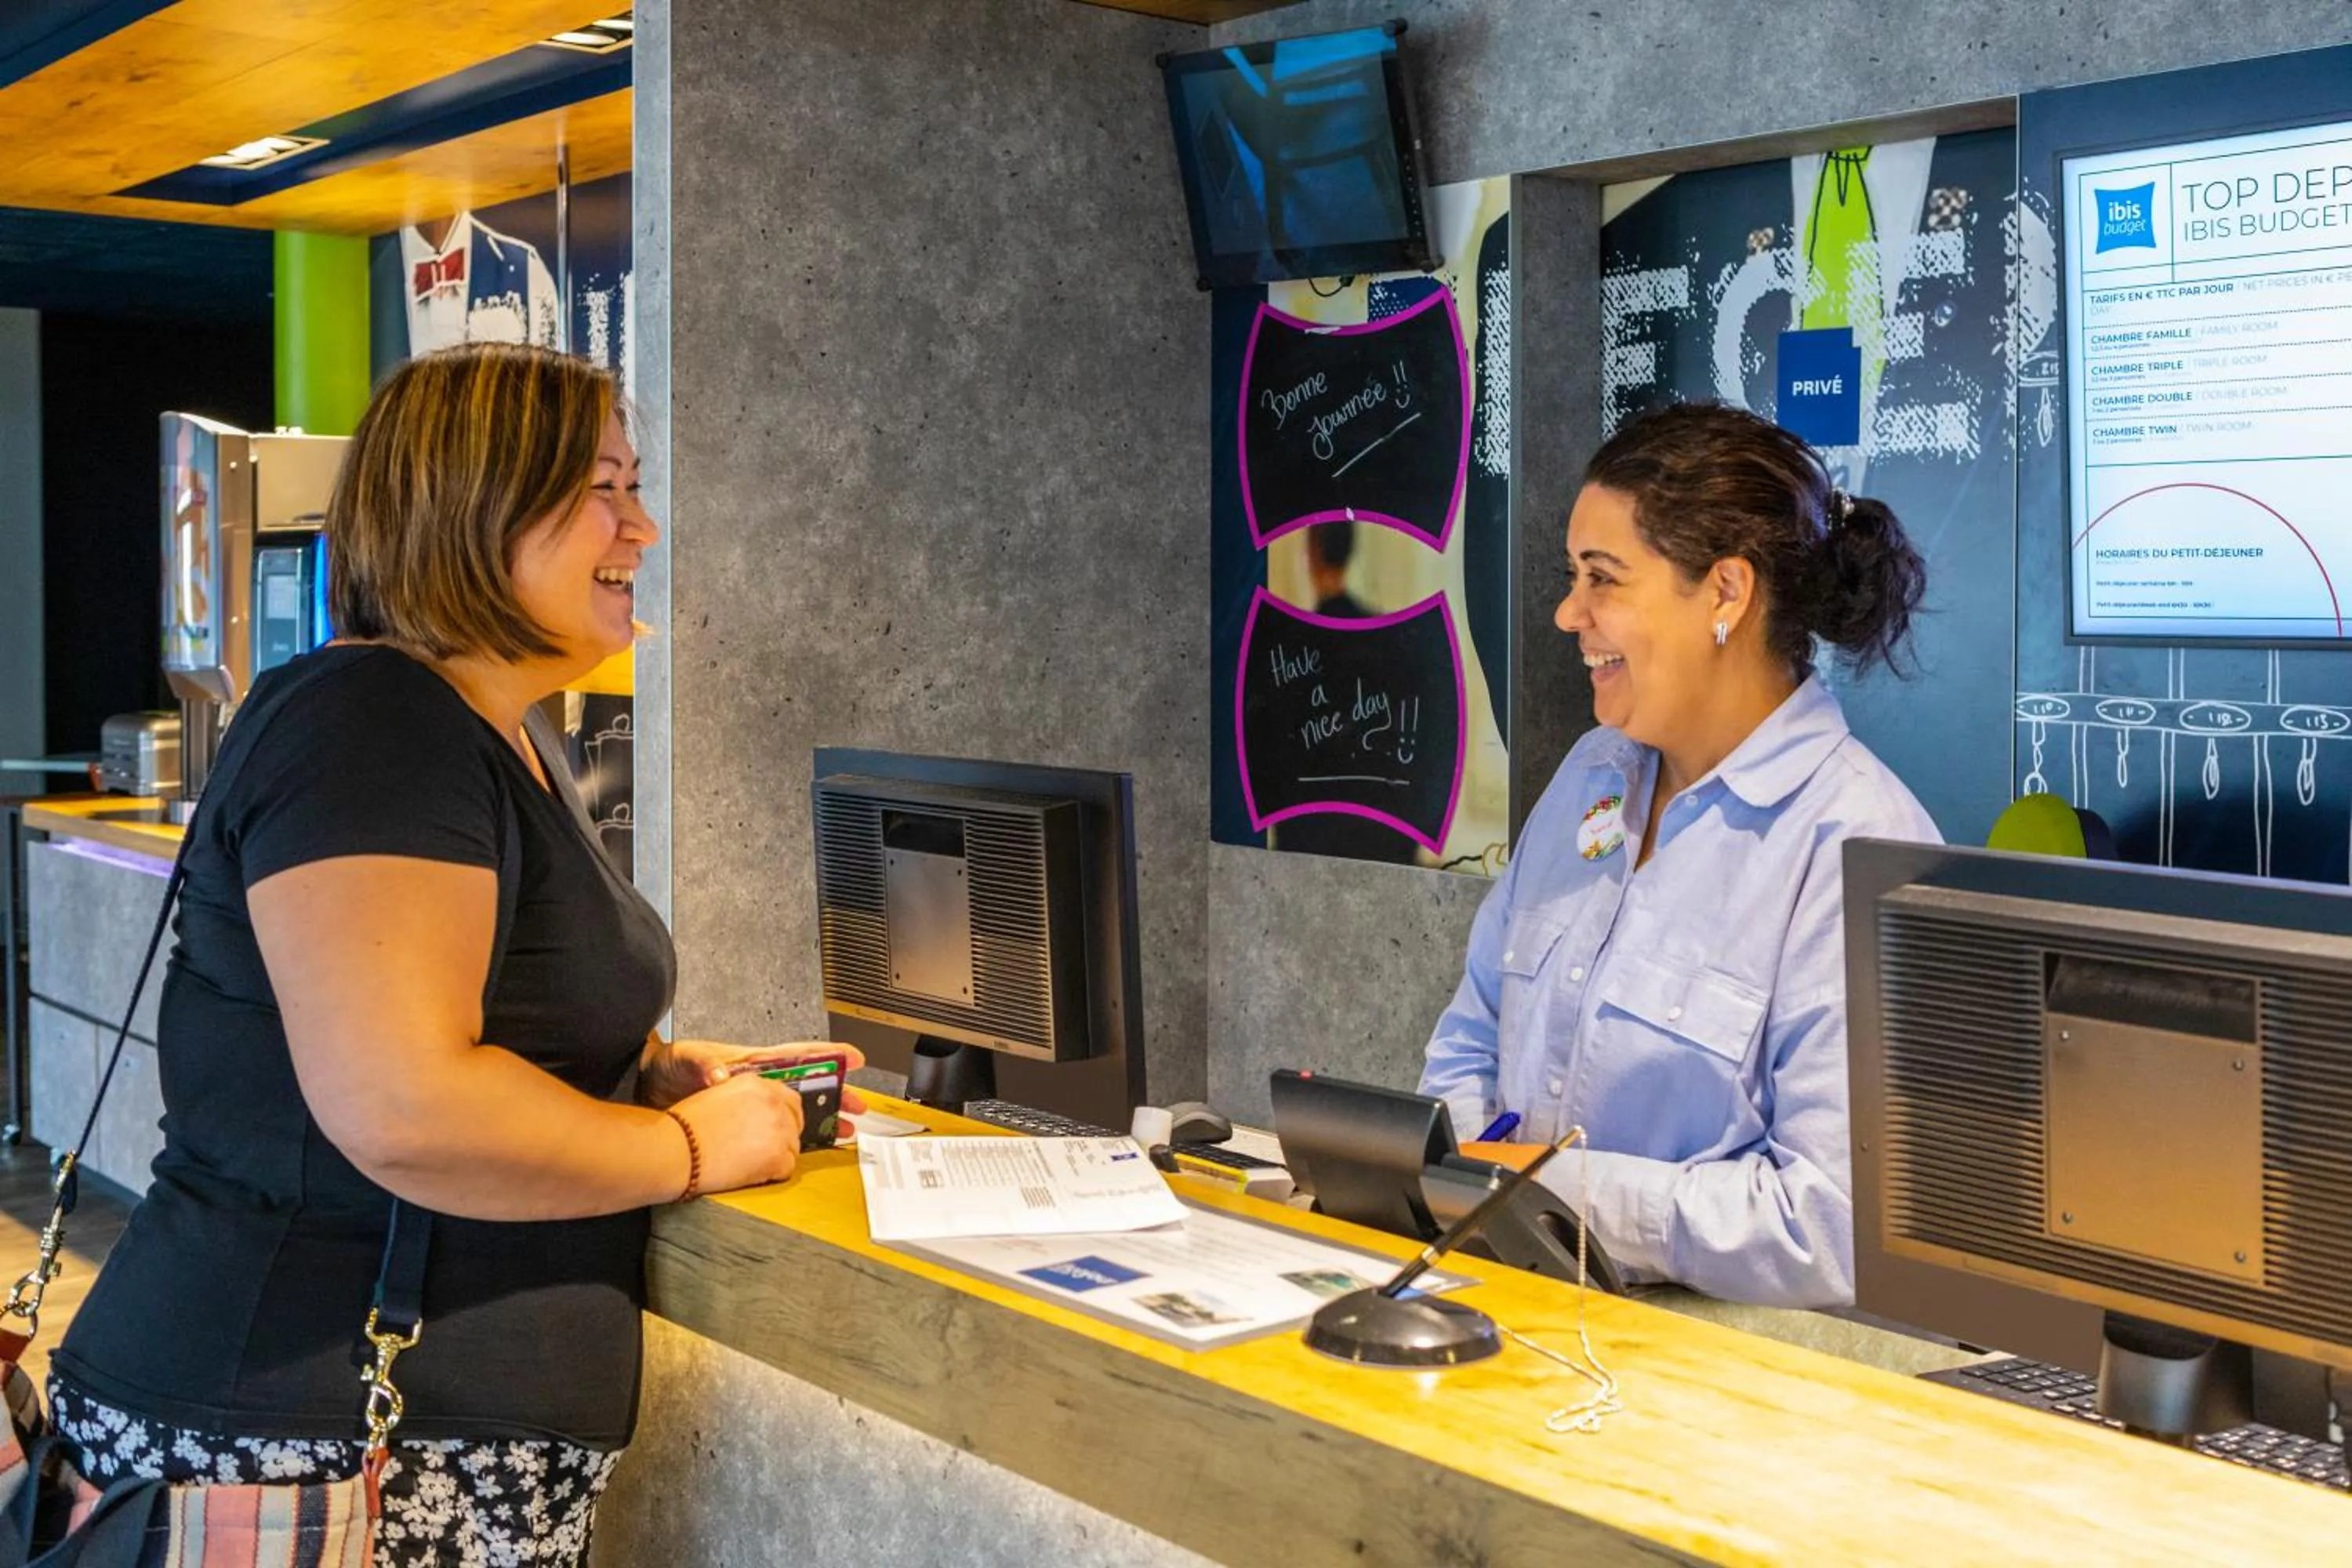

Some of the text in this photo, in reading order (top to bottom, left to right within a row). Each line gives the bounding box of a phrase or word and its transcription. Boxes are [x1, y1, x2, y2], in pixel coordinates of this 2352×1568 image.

[2182, 176, 2259, 212] TOP
[2107, 200, 2141, 222] ibis
[2184, 202, 2352, 242] IBIS BUDGET
[2103, 219, 2147, 237] budget
[2089, 293, 2126, 305] TARIFS
[2129, 292, 2143, 302] EN
[2145, 290, 2154, 300] €
[2157, 289, 2176, 299] TTC
[2179, 287, 2201, 296] PAR
[2203, 283, 2234, 295] JOUR
[2267, 276, 2309, 288] PRICES
[2310, 274, 2324, 285] IN
[2091, 331, 2144, 345] CHAMBRE
[2146, 327, 2192, 339] FAMILLE
[2091, 363, 2144, 376] CHAMBRE
[2147, 360, 2184, 372] TRIPLE
[1792, 374, 1843, 397] PRIVÉ
[1260, 372, 1328, 430] Bonne
[2092, 394, 2145, 407] CHAMBRE
[2147, 390, 2194, 404] DOUBLE
[2092, 426, 2146, 438] CHAMBRE
[2148, 425, 2178, 435] TWIN
[2096, 546, 2263, 559] HORAIRES DU PETIT-DÉJEUNER
[1270, 644, 1323, 687] Have
[1311, 684, 1329, 707] a
[1301, 711, 1343, 750] nice
[1352, 677, 1392, 751] day
